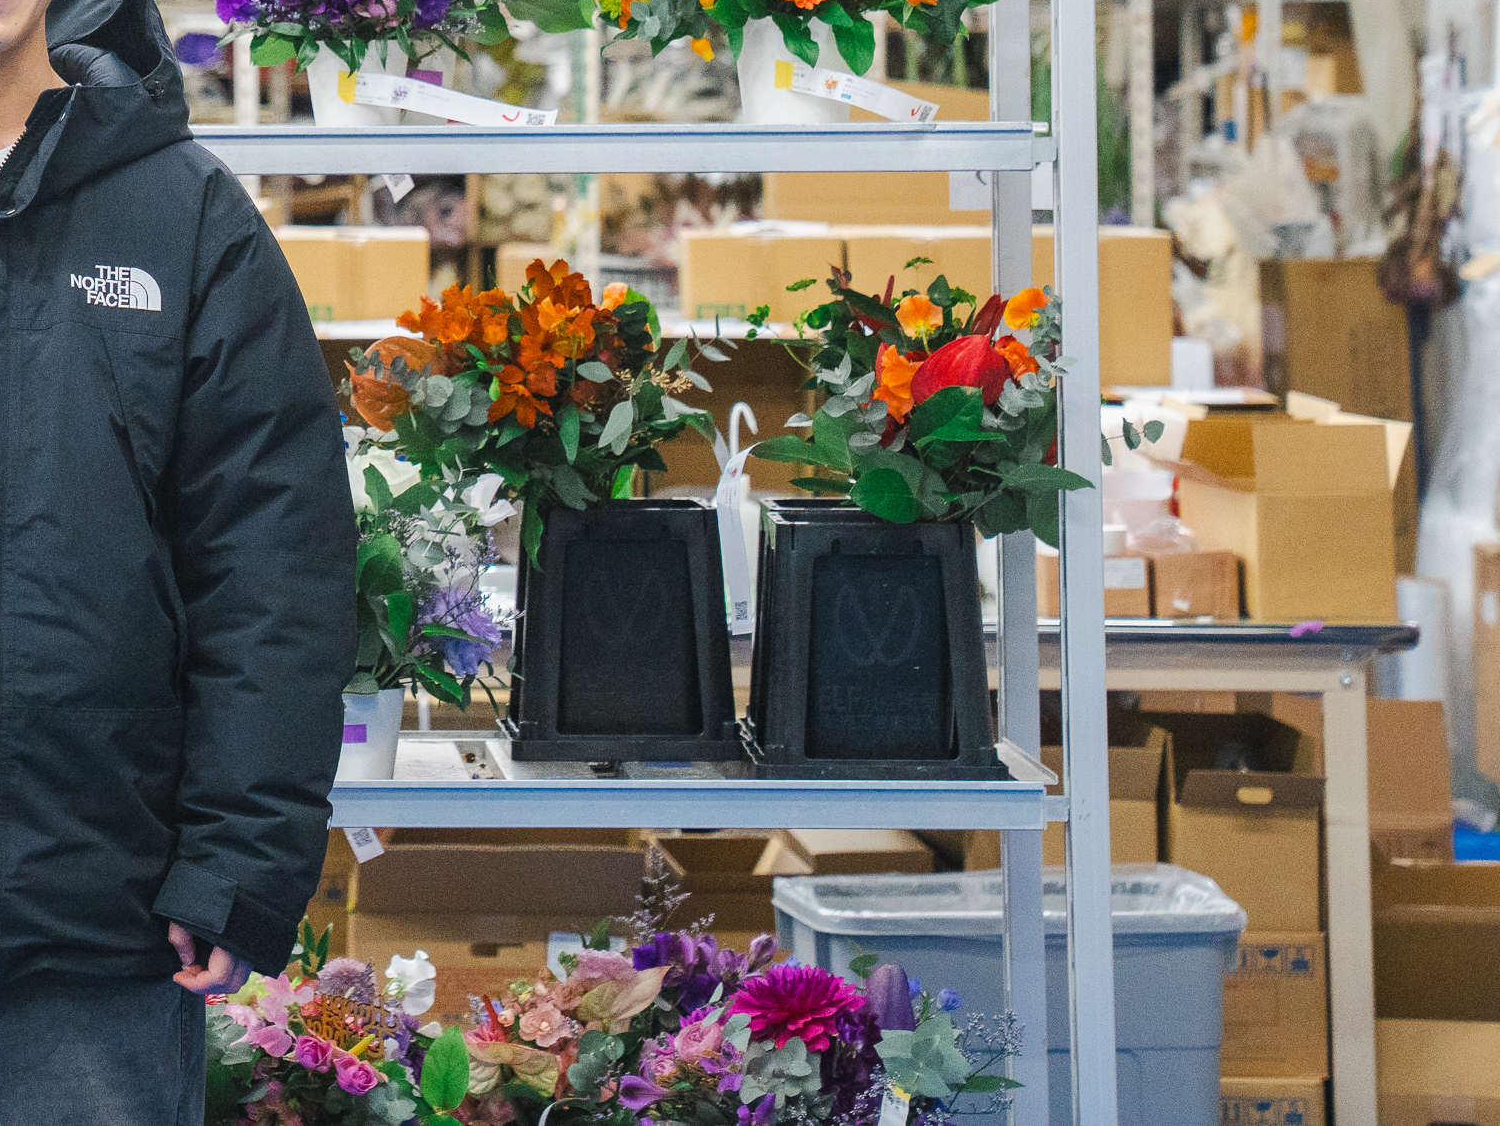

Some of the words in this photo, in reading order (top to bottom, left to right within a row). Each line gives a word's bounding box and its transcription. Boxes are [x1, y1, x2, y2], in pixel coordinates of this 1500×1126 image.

[95, 264, 130, 281] THE
[70, 273, 130, 294] NORTH
[86, 290, 130, 308] FACE
